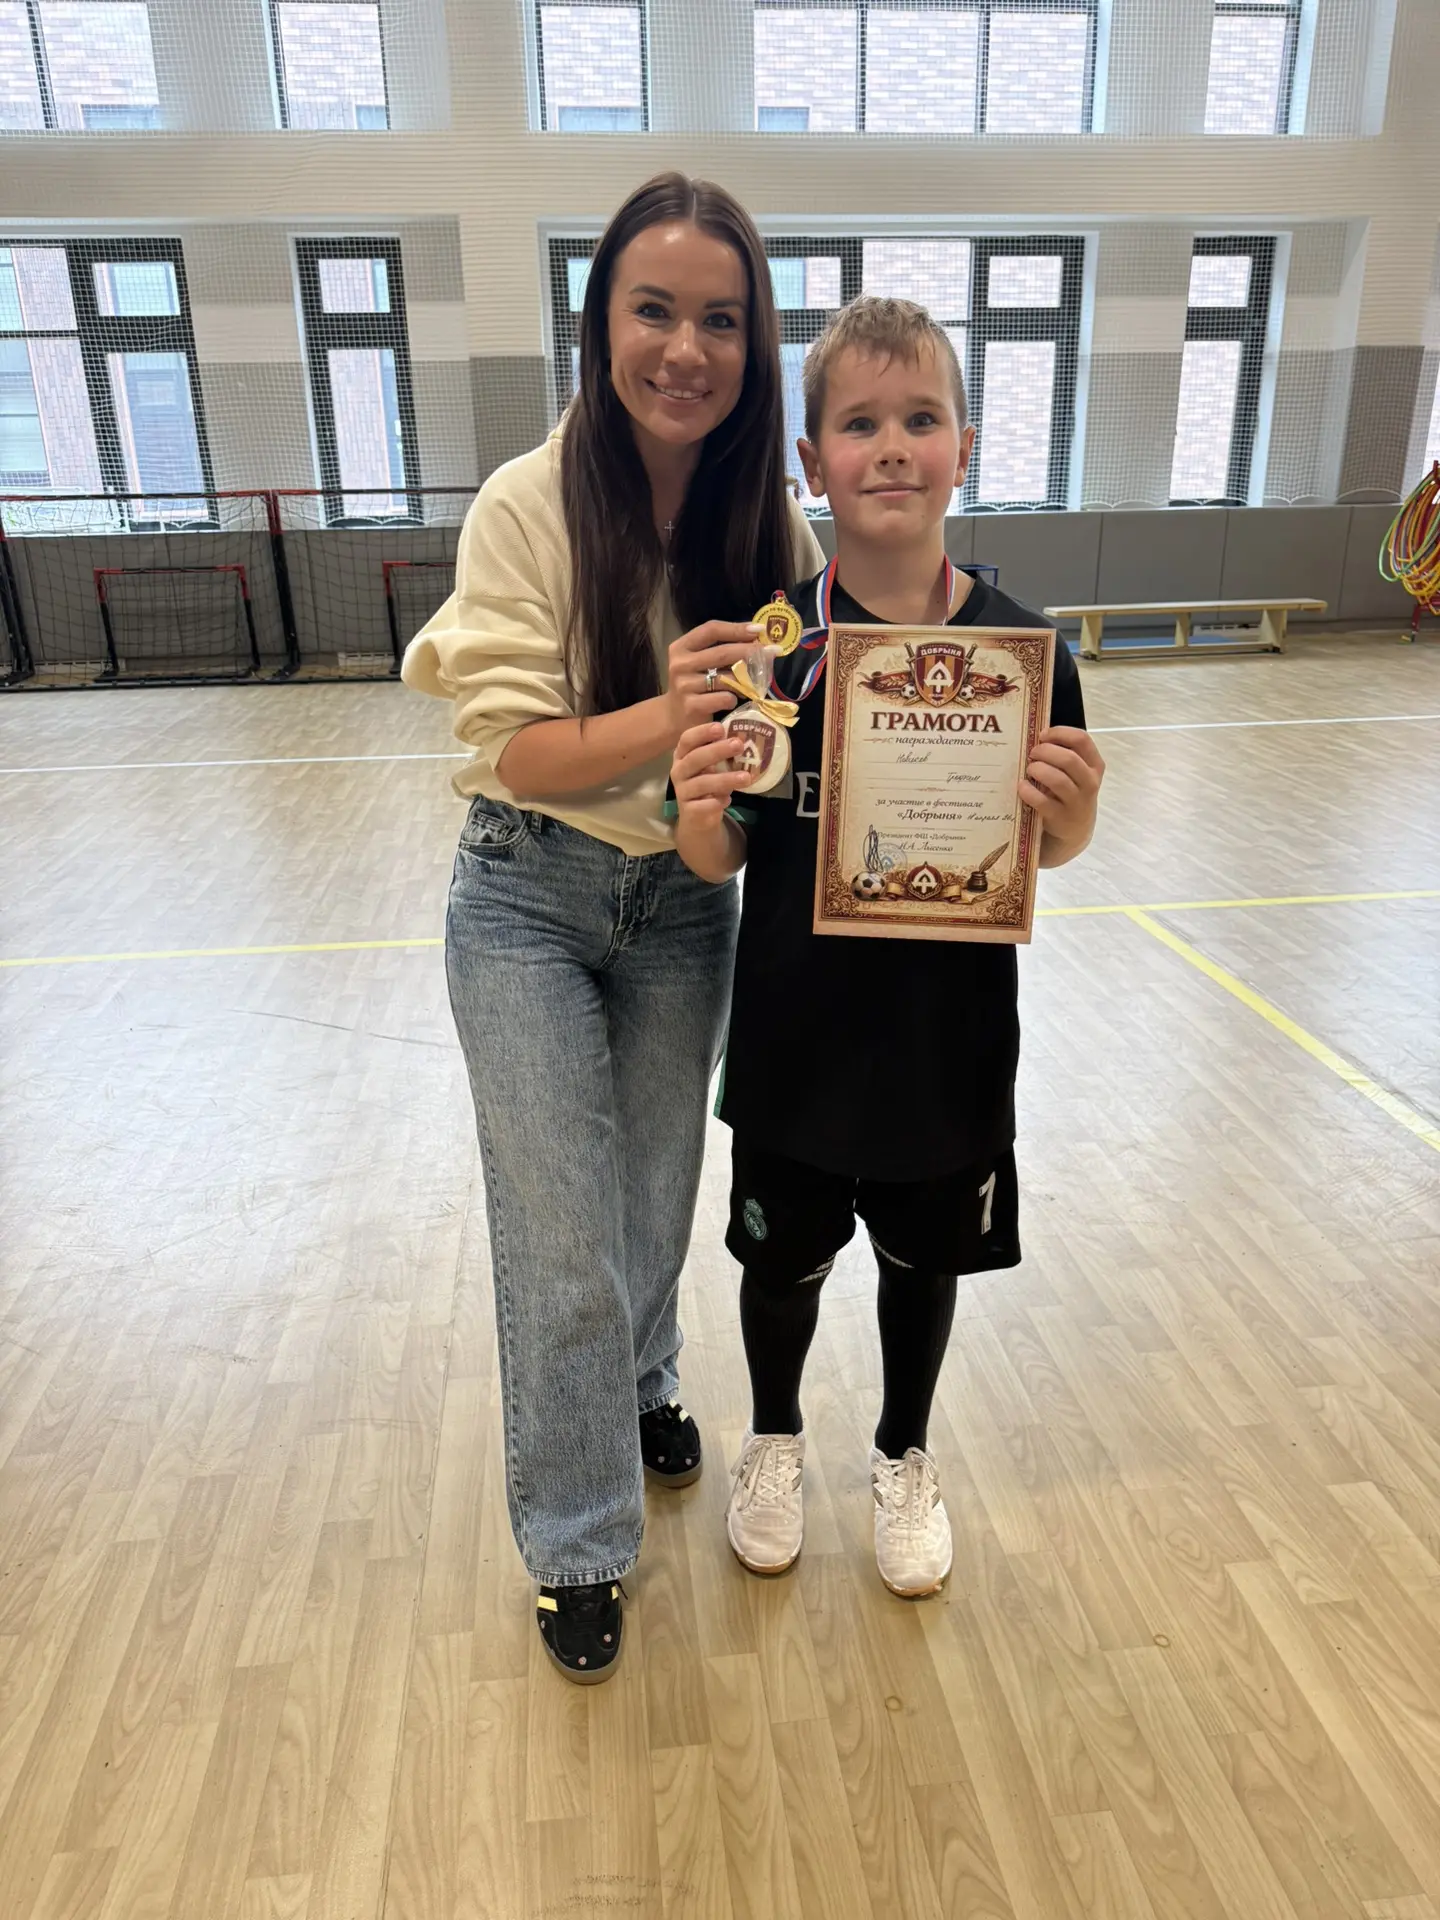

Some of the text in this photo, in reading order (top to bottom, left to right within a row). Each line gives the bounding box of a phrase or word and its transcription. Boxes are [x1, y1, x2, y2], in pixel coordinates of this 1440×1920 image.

[920, 647, 962, 657] ДОБРЫНЯ
[870, 711, 1003, 733] ГРАМОТА
[732, 723, 773, 737] ДОБРЫНЯ
[895, 735, 975, 748] награждается
[875, 799, 886, 807] за
[887, 799, 924, 807] участие
[933, 798, 984, 809] фестивале
[897, 808, 962, 824] «Добрыня»
